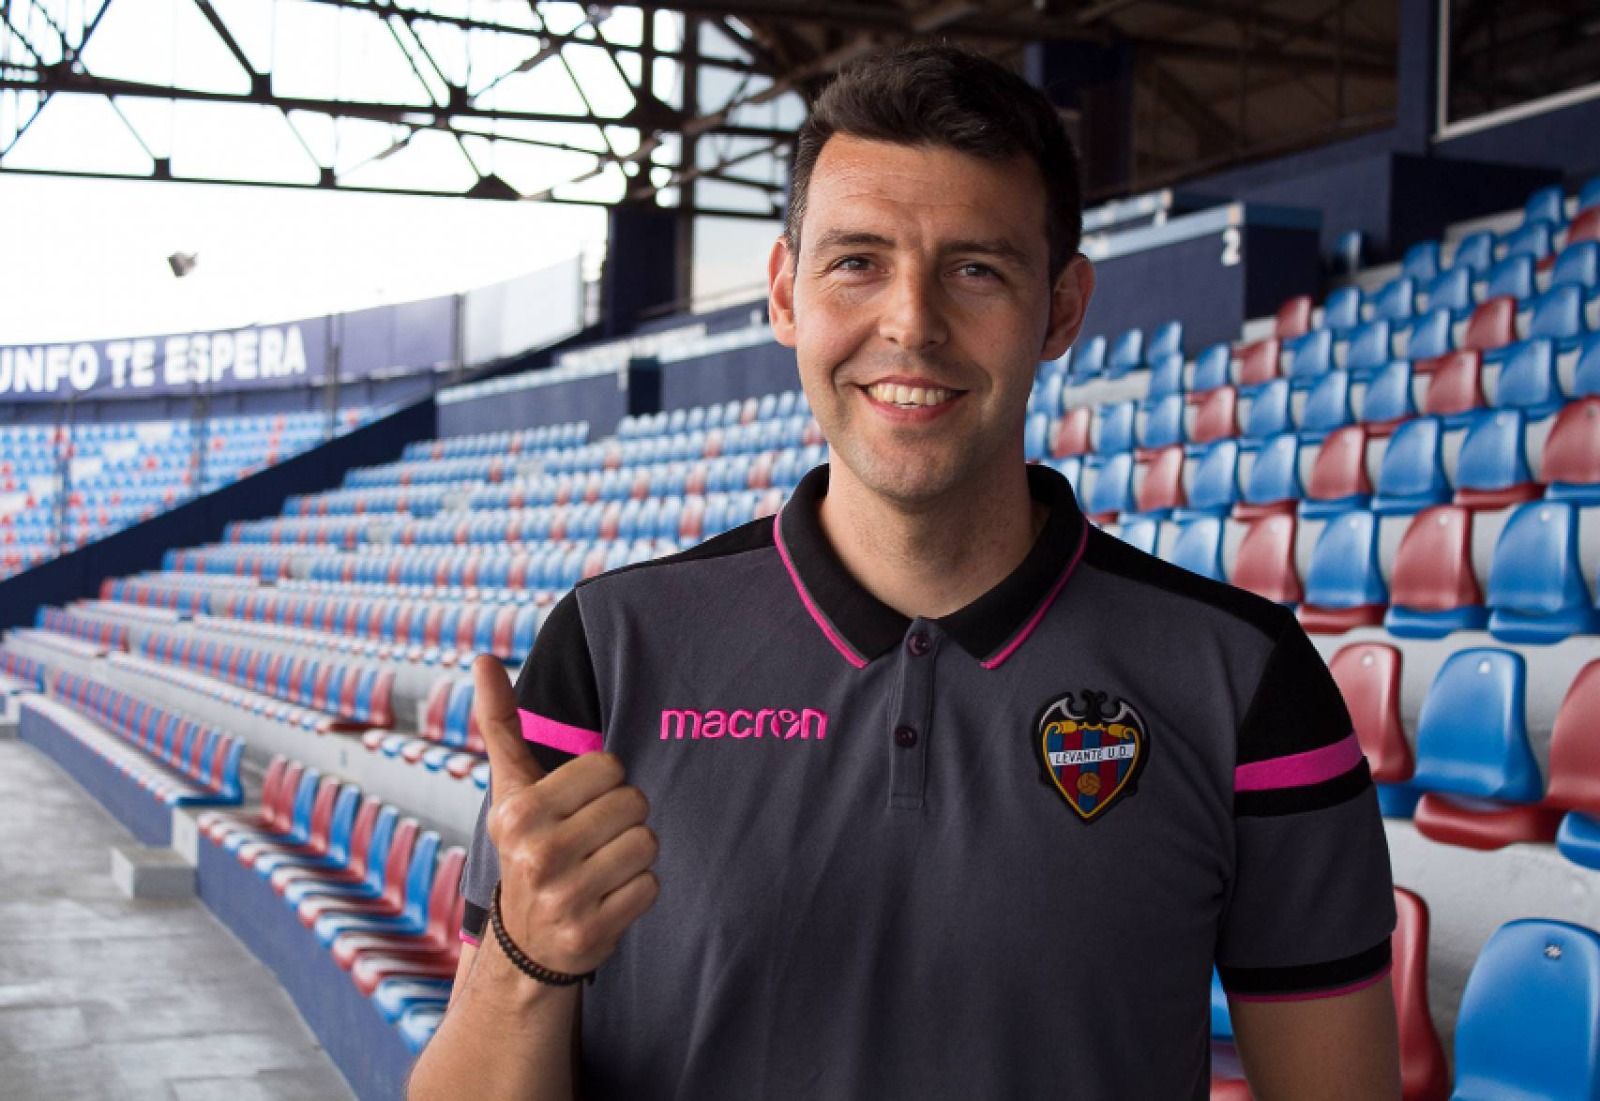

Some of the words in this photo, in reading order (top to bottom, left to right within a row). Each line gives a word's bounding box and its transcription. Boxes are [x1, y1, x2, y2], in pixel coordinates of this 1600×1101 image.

[1221, 228, 1241, 266] 2
[106, 339, 156, 388] TE
[164, 324, 307, 385] ESPERA
[659, 708, 828, 741] macron
[1055, 749, 1103, 764] LEVANTE
